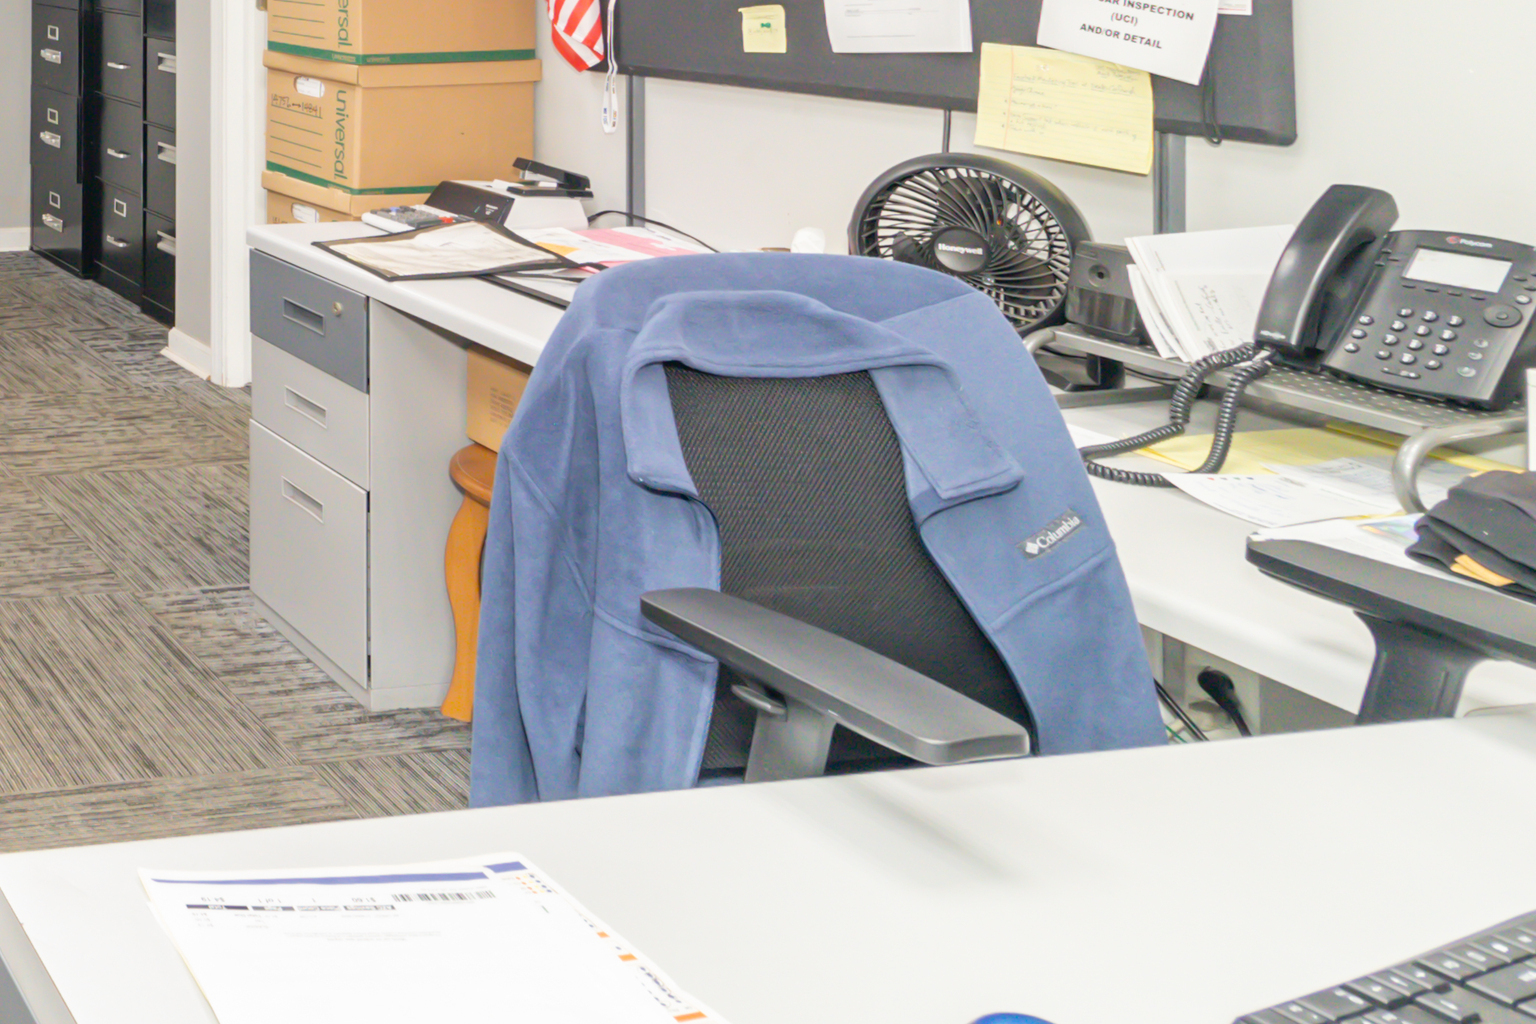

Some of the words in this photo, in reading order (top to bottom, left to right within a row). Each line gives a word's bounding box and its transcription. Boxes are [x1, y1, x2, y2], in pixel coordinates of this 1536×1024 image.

[1110, 12, 1139, 26] (UCI)
[1123, 0, 1195, 21] INSPECTION
[1080, 23, 1121, 39] AND/OR
[1123, 33, 1163, 49] DETAIL
[333, 89, 349, 181] universal
[937, 242, 984, 255] Honeywell
[1036, 516, 1081, 549] Columbia
